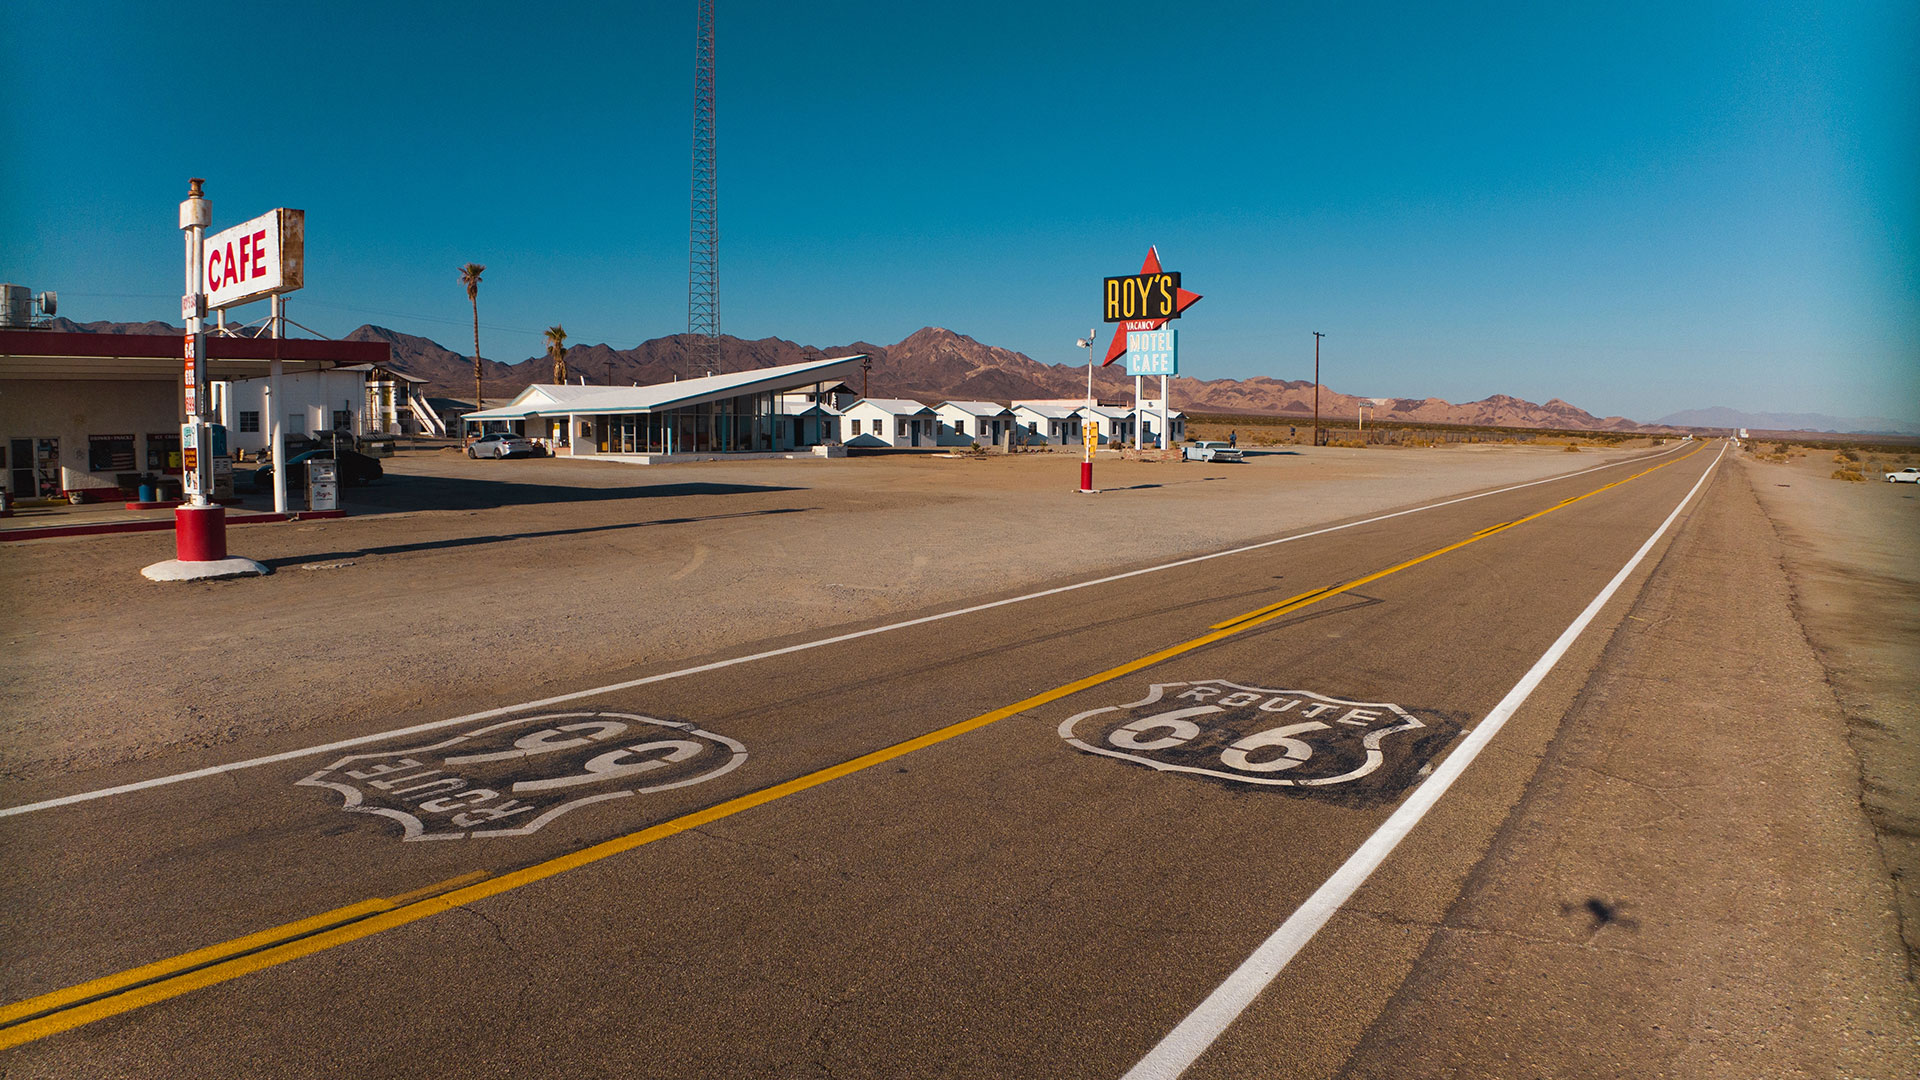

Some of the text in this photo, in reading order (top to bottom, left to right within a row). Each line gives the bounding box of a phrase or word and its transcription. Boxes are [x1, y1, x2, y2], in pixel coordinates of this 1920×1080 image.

[208, 229, 266, 292] CAFE
[1107, 274, 1172, 319] ROY'S
[1126, 320, 1155, 331] VACANCY
[1129, 332, 1172, 353] MOTEL
[1132, 353, 1168, 373] CAFE
[1176, 686, 1383, 727] ROUTE
[445, 721, 704, 792] 66
[1108, 705, 1332, 772] 66
[345, 758, 536, 828] ROUTE
